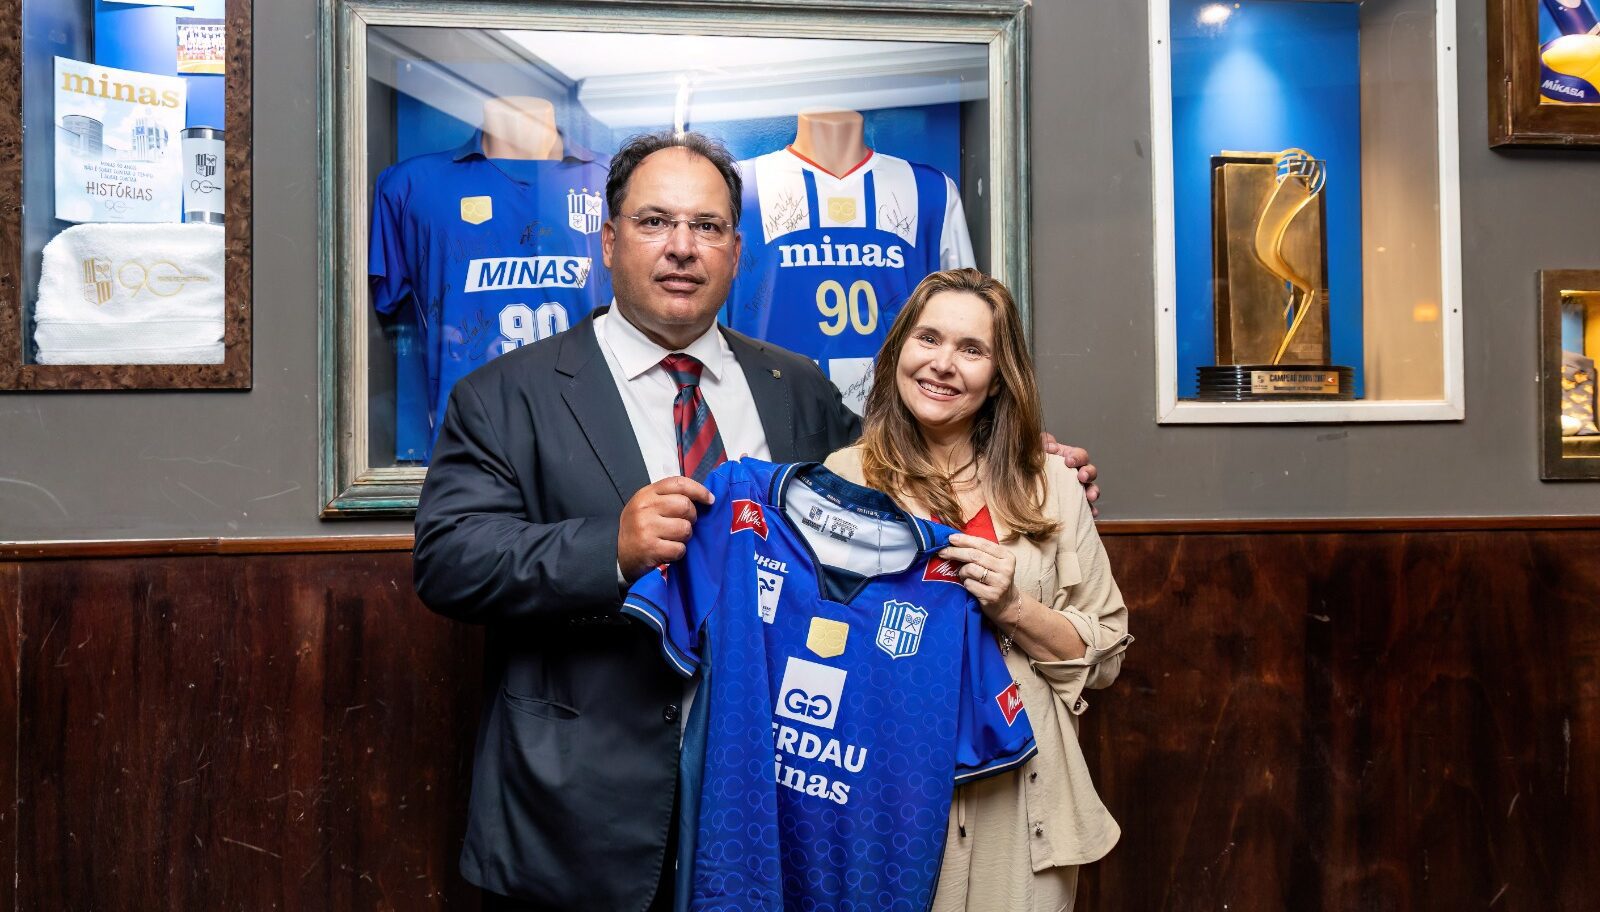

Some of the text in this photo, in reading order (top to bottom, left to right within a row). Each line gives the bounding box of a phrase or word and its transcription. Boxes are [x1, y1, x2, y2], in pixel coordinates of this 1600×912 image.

[61, 70, 181, 109] minas
[86, 181, 153, 202] HISTÓRIAS
[477, 259, 580, 288] MINAS
[778, 234, 905, 269] minas
[499, 302, 570, 354] 90
[815, 279, 879, 336] 90
[771, 721, 868, 773] RDAU
[774, 753, 851, 805] inas
